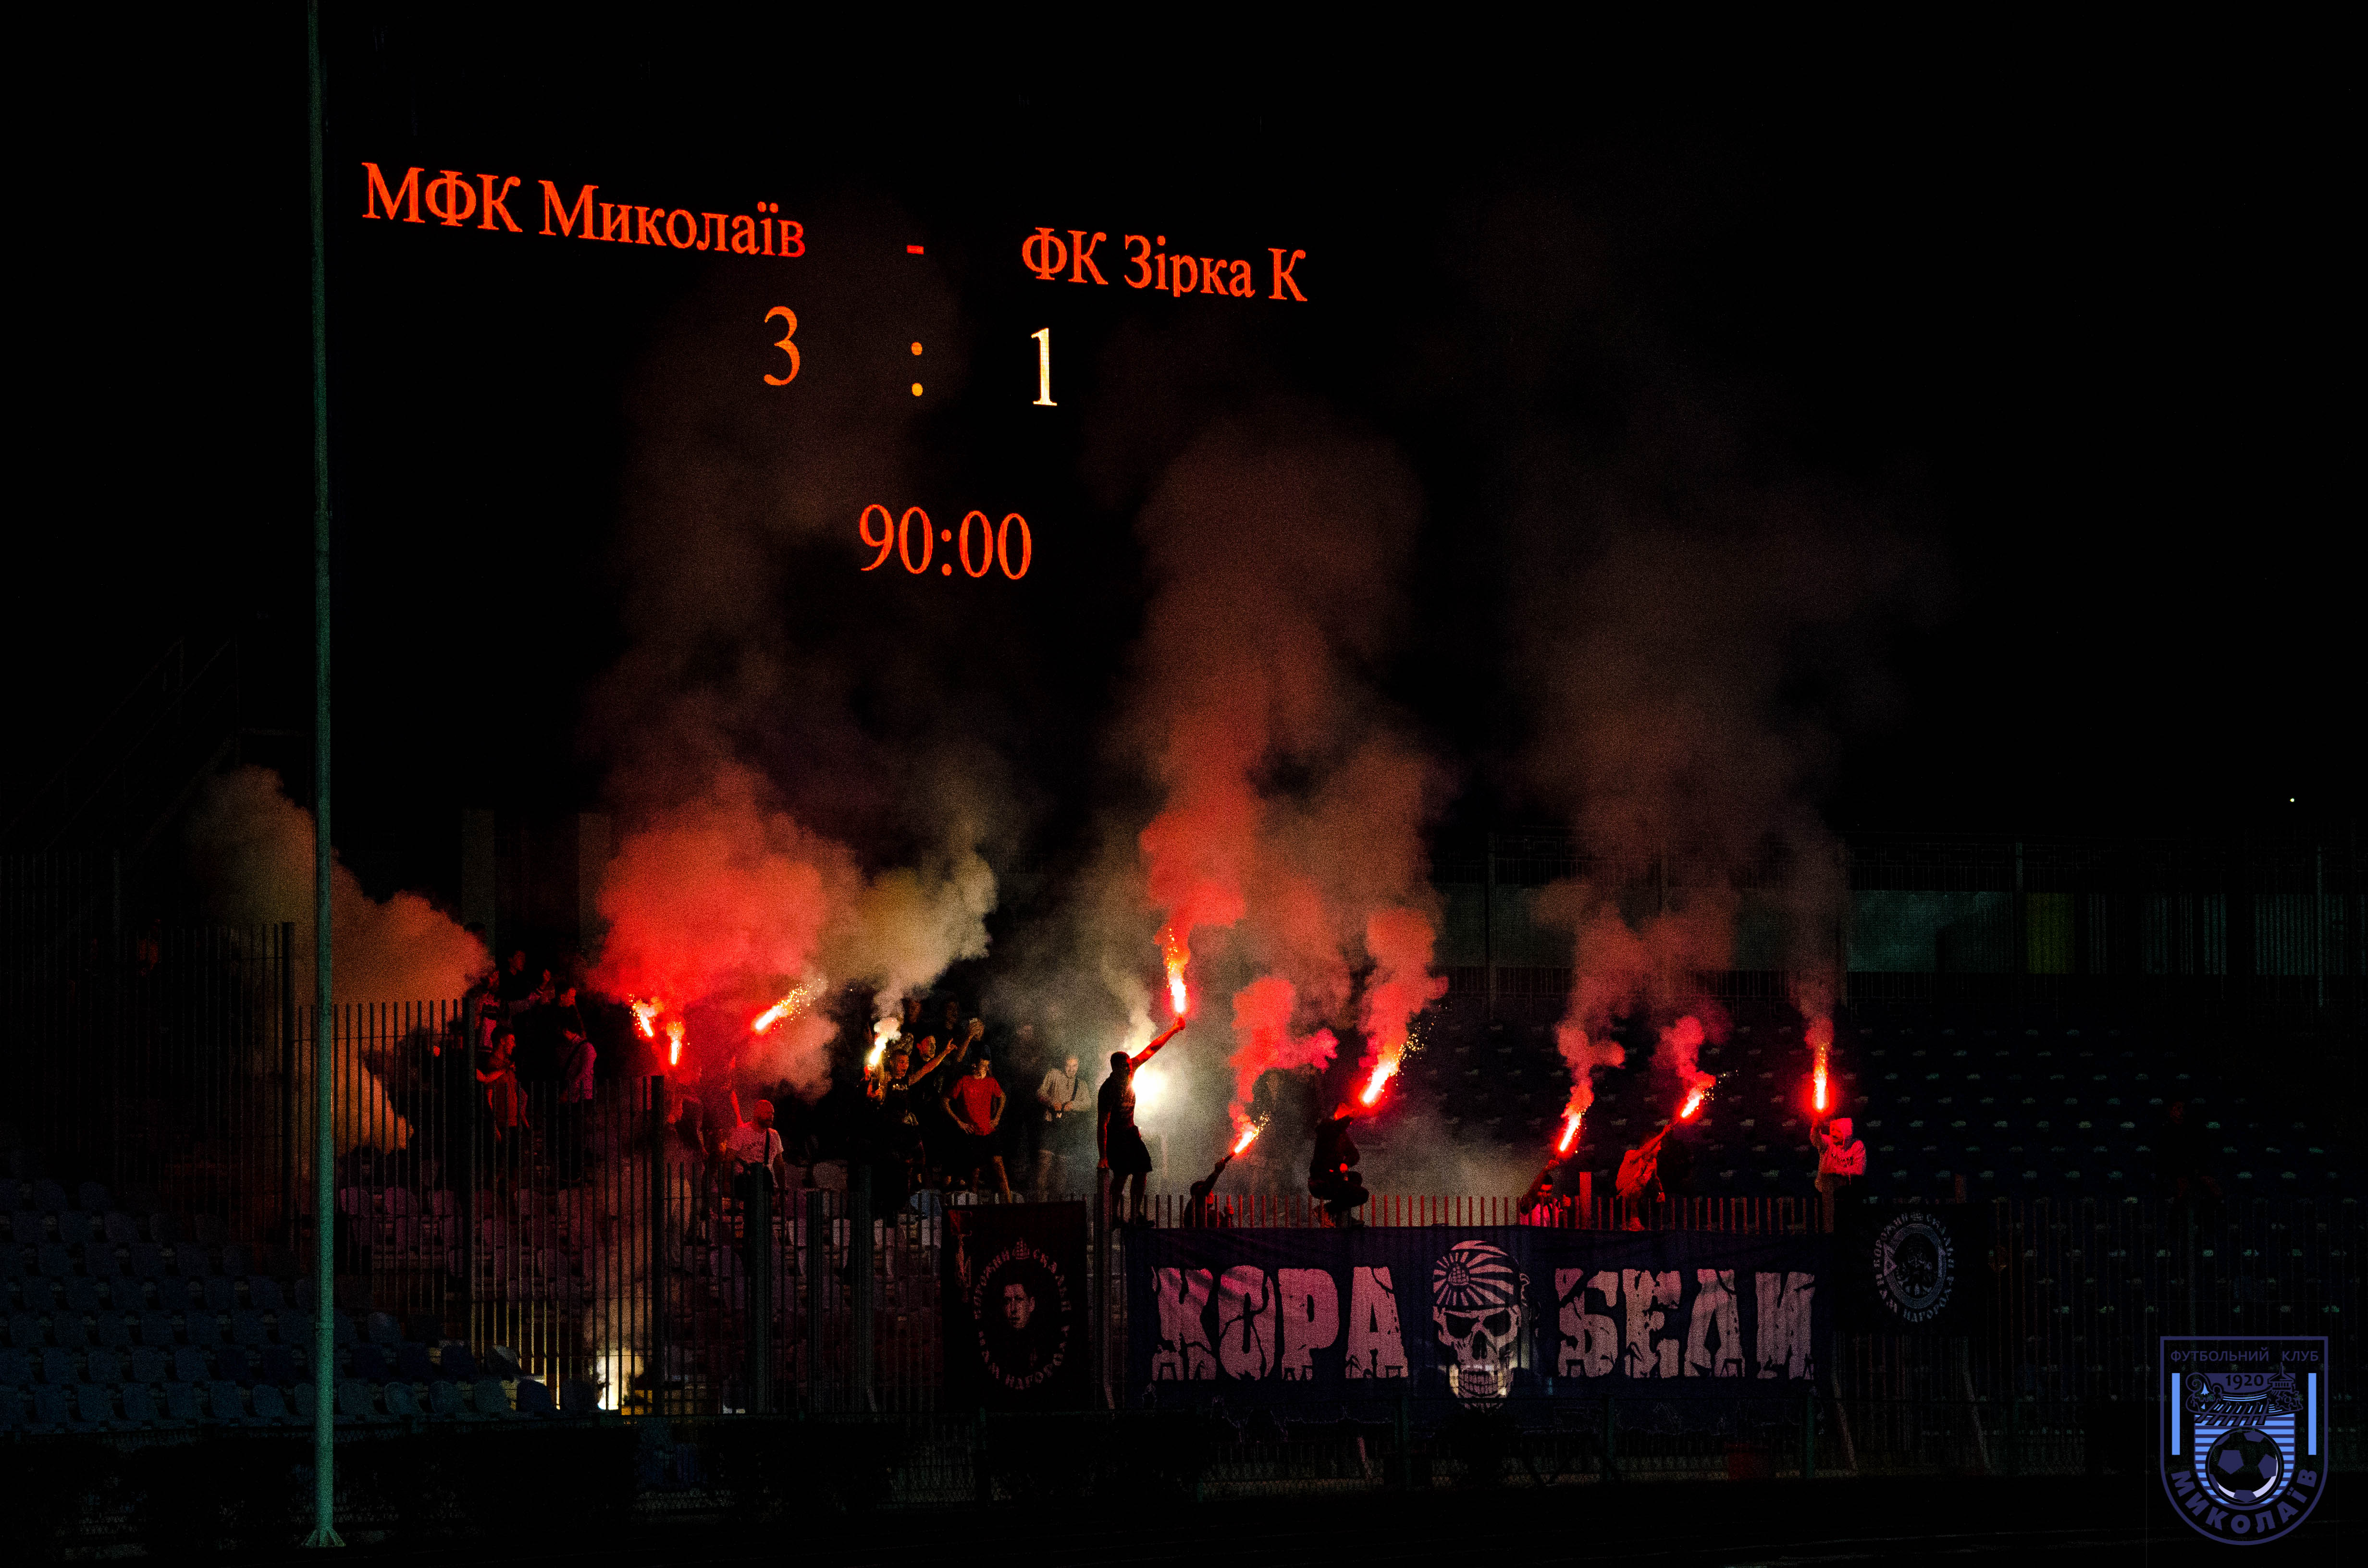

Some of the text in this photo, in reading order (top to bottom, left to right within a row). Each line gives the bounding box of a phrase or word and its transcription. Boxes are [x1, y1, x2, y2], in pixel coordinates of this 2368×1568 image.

[362, 162, 522, 232] МФК
[538, 180, 805, 257] Миколаїв
[1022, 227, 1108, 285] ФК
[1124, 235, 1255, 298] Зірка
[1268, 248, 1307, 301] К
[764, 306, 800, 386] 3
[1031, 328, 1057, 406] 1
[859, 504, 1032, 580] 90:00
[1153, 1265, 1815, 1380] КОРА БЕЛИ
